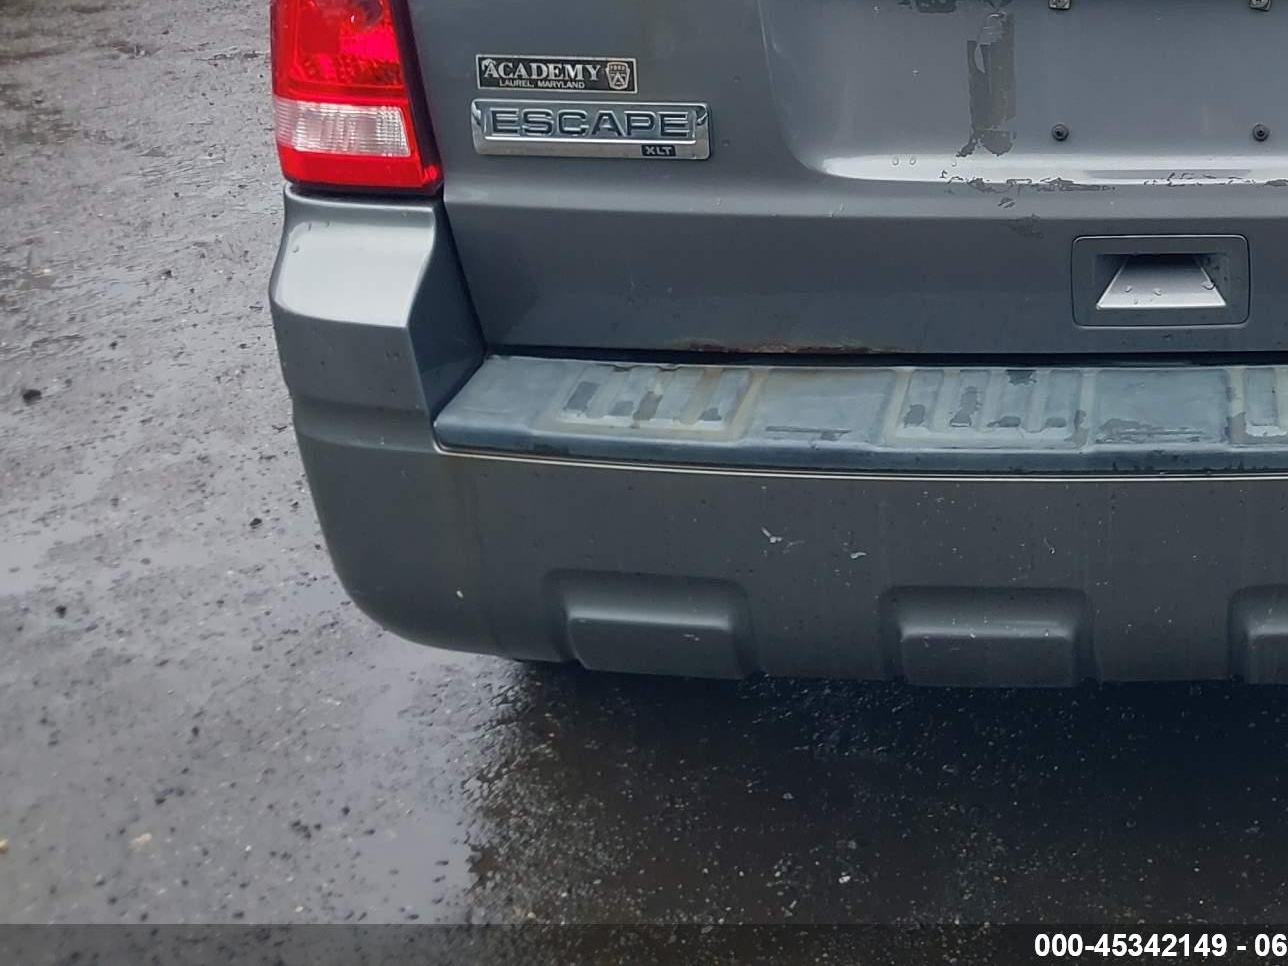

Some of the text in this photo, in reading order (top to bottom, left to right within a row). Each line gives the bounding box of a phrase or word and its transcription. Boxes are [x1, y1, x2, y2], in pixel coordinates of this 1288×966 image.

[481, 58, 602, 81] ACADEMY
[499, 79, 586, 90] LAUREL, MARYLAND
[490, 107, 690, 138] ESCAPE
[643, 145, 675, 156] XLT
